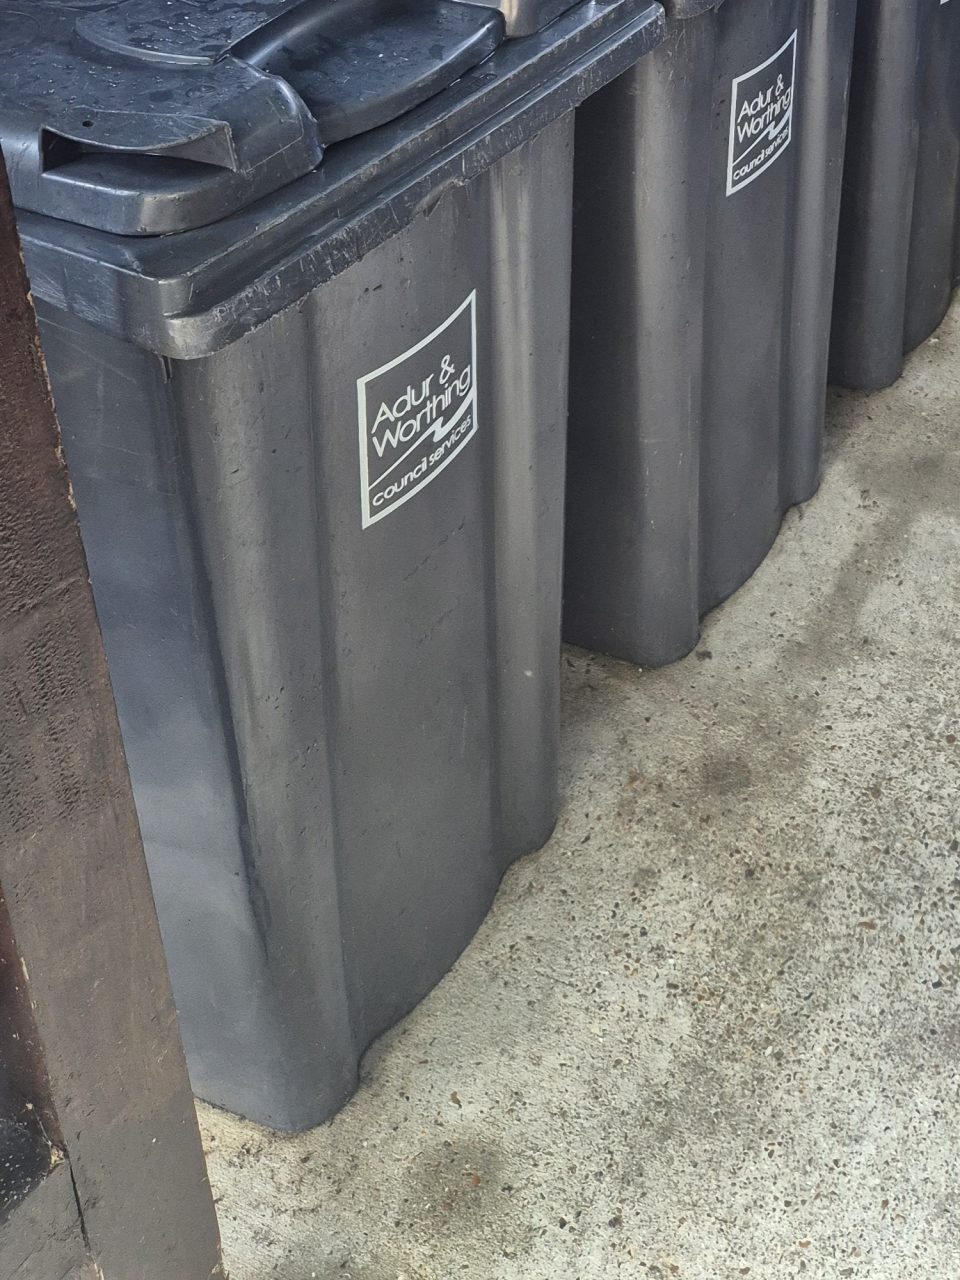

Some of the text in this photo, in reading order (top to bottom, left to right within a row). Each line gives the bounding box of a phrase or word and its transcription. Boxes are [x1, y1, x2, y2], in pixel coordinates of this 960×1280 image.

[736, 73, 784, 124] Adur &
[736, 86, 792, 144] Worthing
[733, 148, 765, 181] council
[371, 354, 455, 434] Adur &
[371, 363, 472, 458] Worthing
[371, 414, 472, 507] council services
